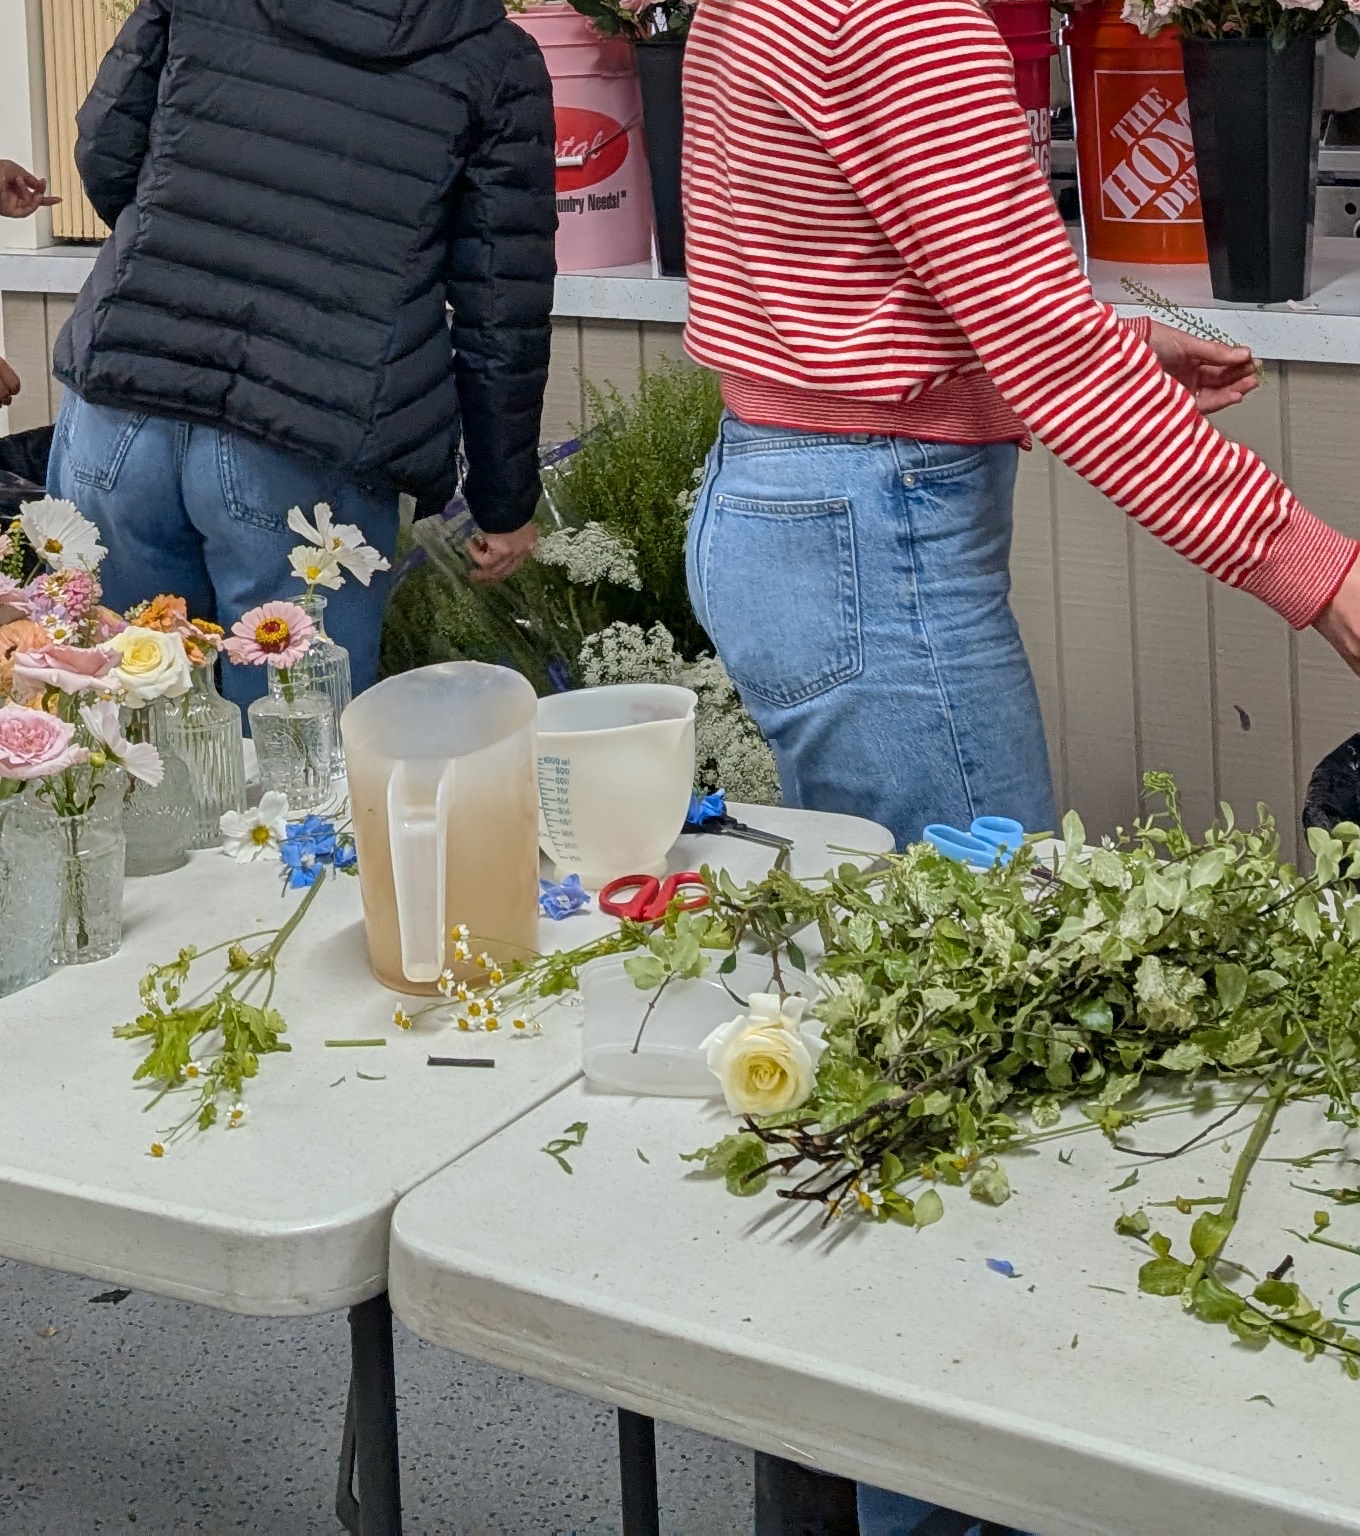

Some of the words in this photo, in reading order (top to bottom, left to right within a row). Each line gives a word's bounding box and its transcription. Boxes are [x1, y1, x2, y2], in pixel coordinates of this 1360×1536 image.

[1110, 87, 1172, 147] THE
[1103, 97, 1196, 220] HOM
[557, 196, 584, 215] untry
